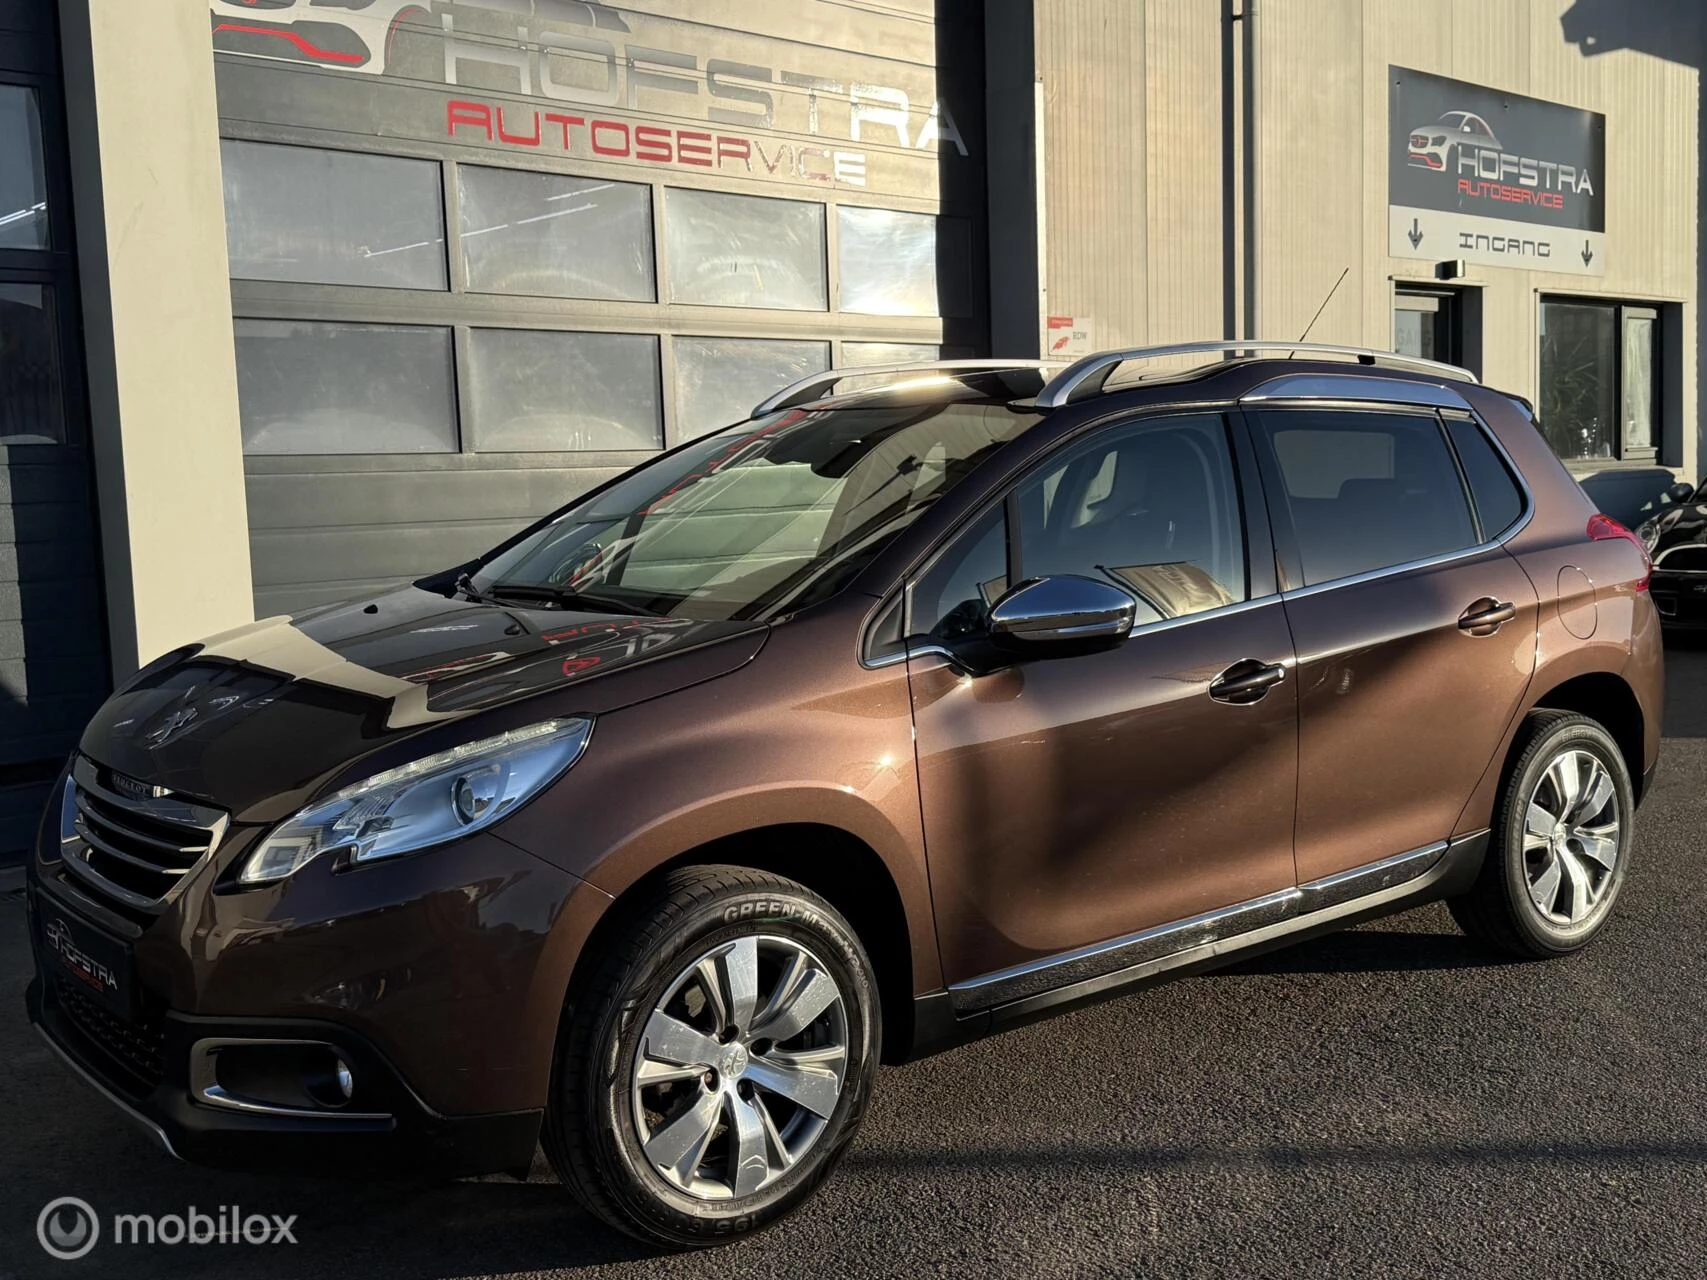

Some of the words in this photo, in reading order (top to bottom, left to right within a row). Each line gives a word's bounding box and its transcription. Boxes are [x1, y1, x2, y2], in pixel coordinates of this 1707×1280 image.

[441, 13, 968, 157] HOFSTRA
[447, 101, 867, 187] AUTOSERVICE
[1457, 144, 1594, 197] HOFSTRA
[1457, 179, 1564, 209] AUTOSERVICE
[1459, 232, 1551, 258] INGANG
[60, 936, 118, 991] HOFSTRA
